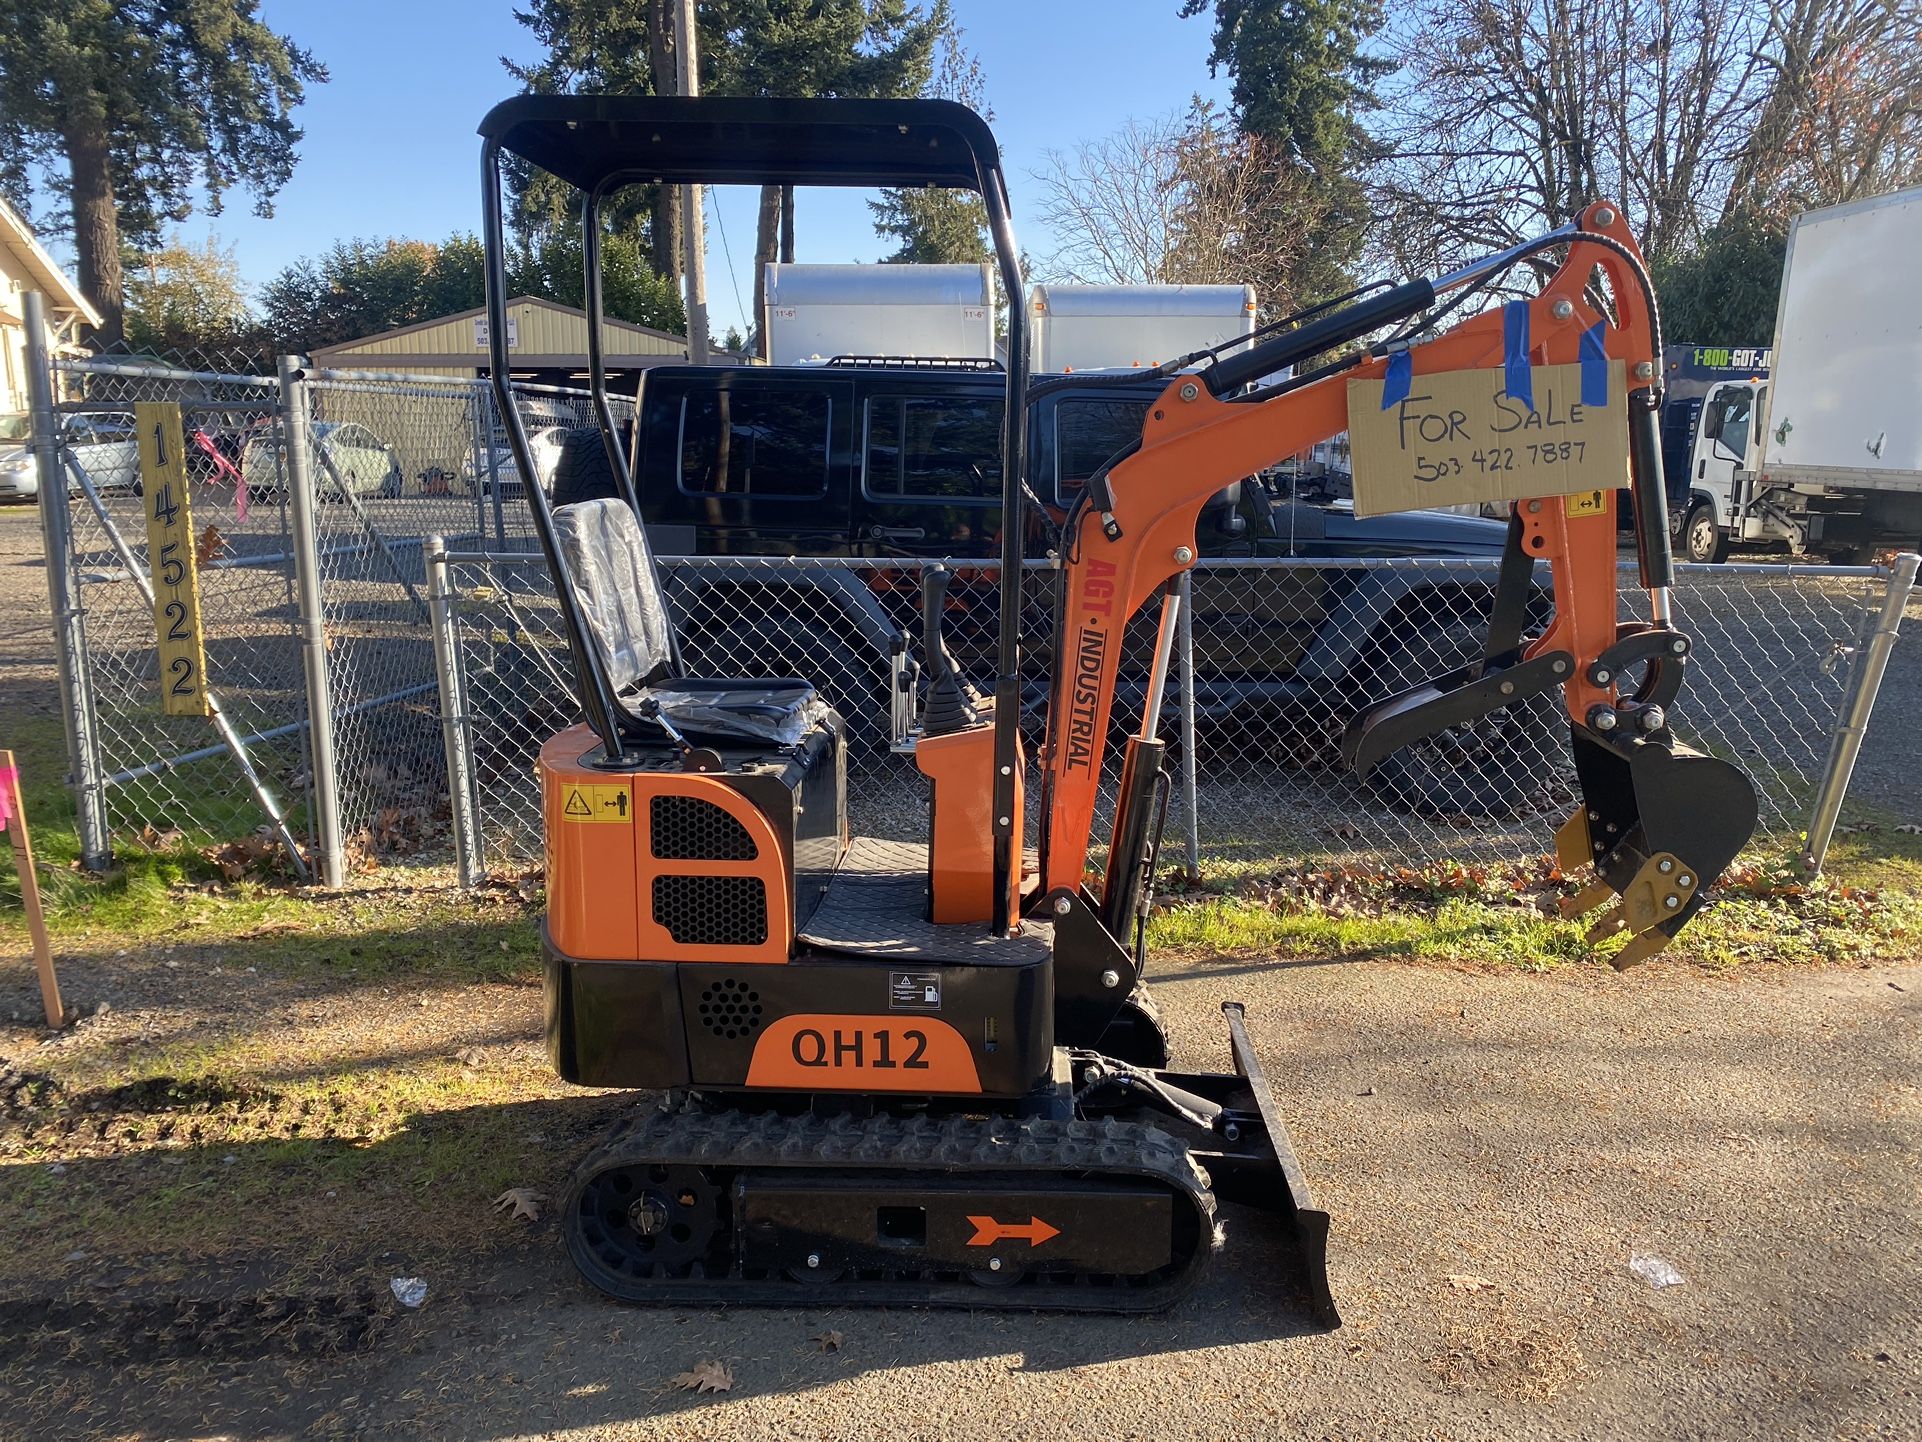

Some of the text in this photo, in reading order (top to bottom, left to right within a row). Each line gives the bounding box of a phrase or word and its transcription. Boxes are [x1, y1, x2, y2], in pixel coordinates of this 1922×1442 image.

[153, 421, 196, 697] 14522
[1067, 558, 1117, 771] AGT INDUSTRIAL
[791, 1028, 929, 1069] QH12
